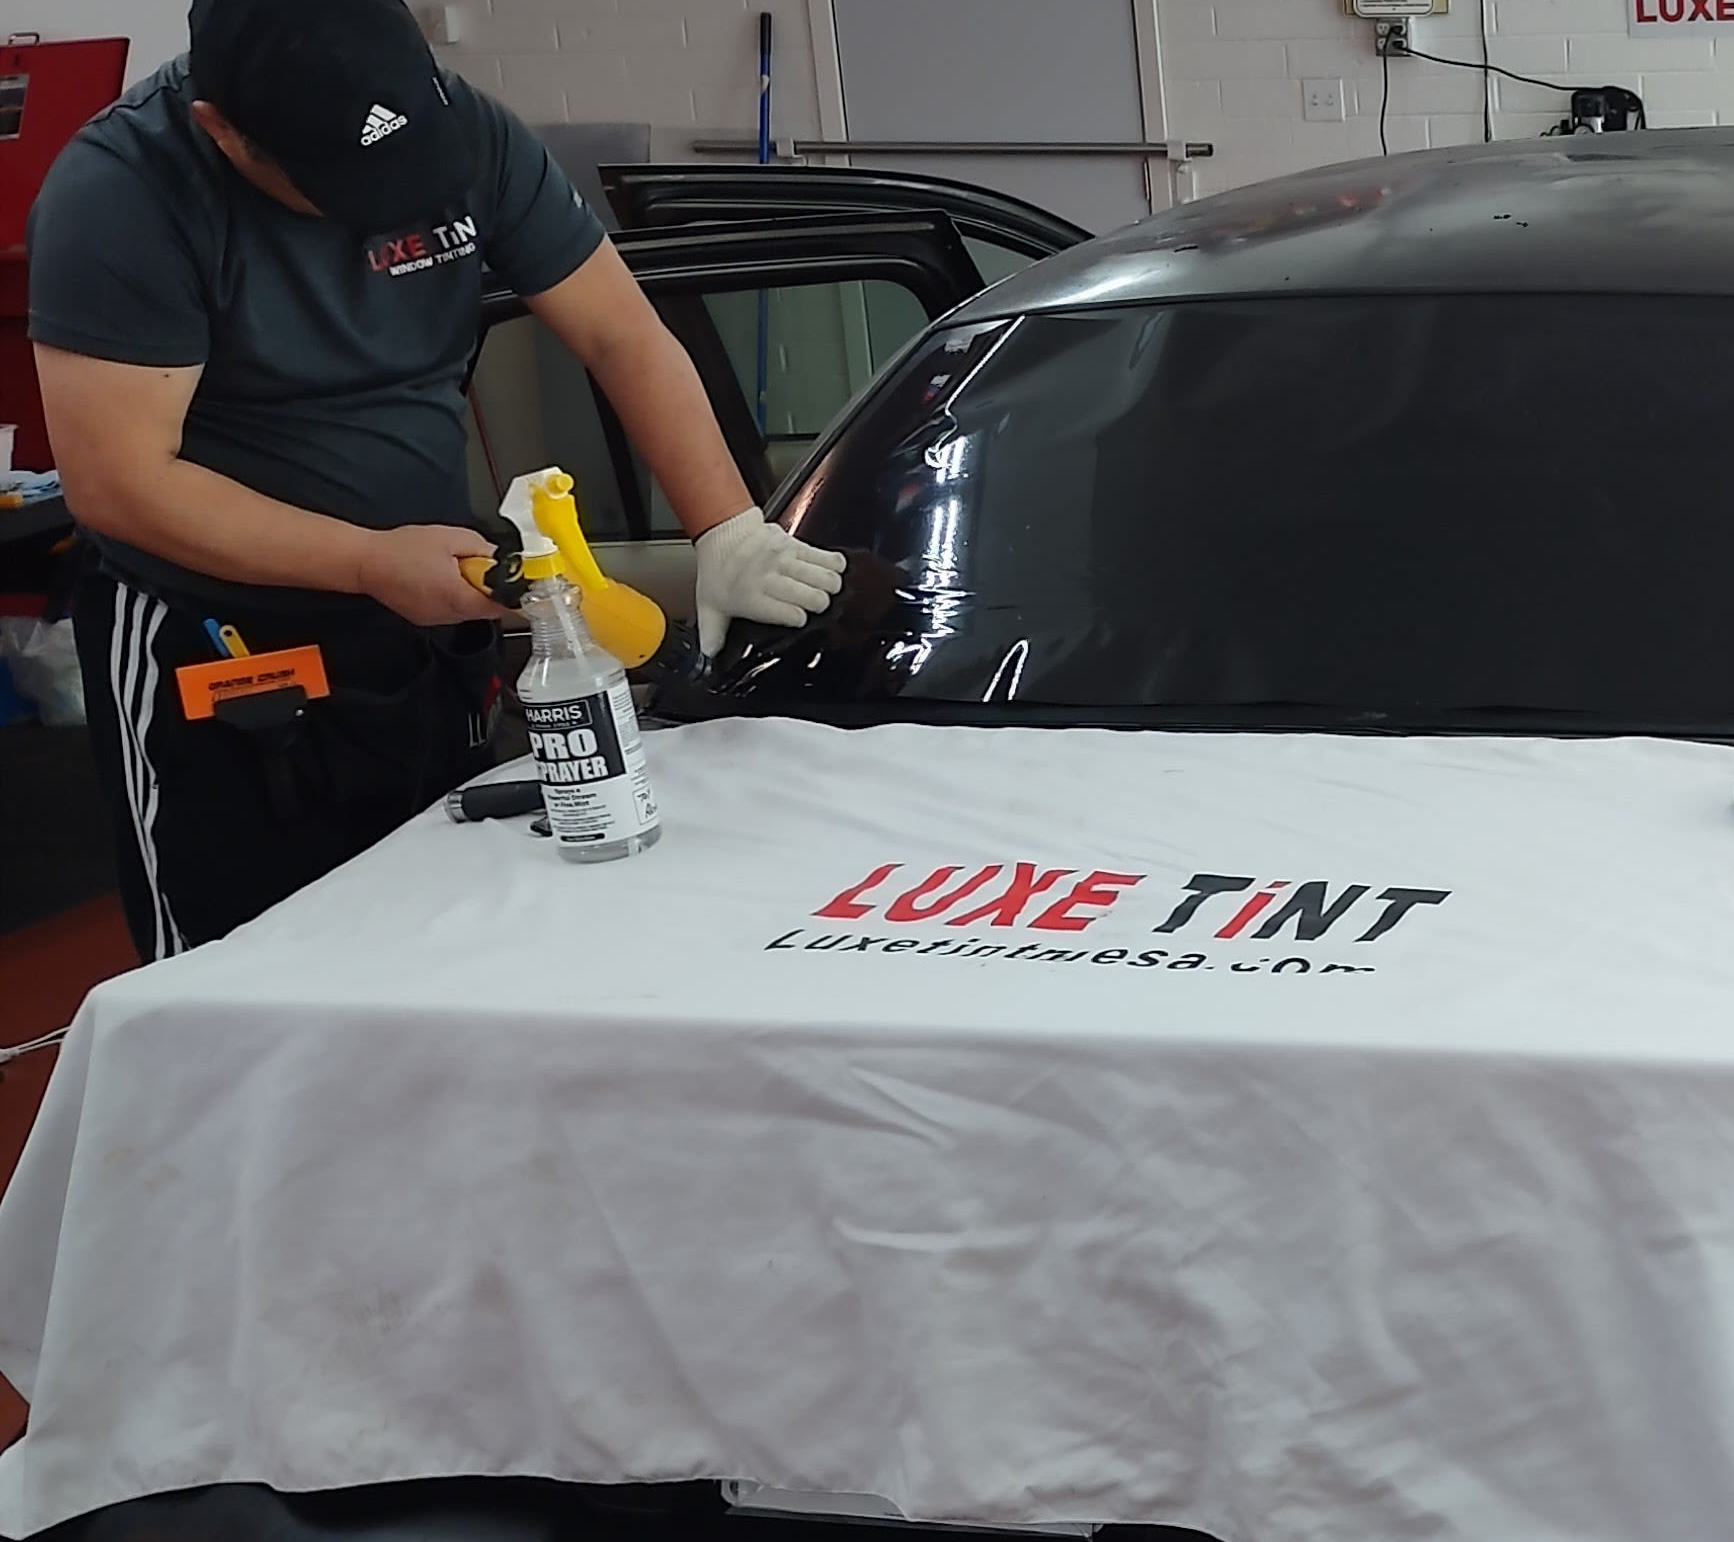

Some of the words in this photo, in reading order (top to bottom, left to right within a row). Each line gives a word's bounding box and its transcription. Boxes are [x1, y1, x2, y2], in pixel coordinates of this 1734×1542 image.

[360, 115, 408, 146] adidas
[389, 256, 434, 277] WINDOW
[434, 241, 477, 265] TINTING
[525, 704, 583, 723] HARRIS
[528, 728, 598, 760] PRO
[537, 755, 609, 783] PRAYER
[811, 863, 1147, 932] LUXE
